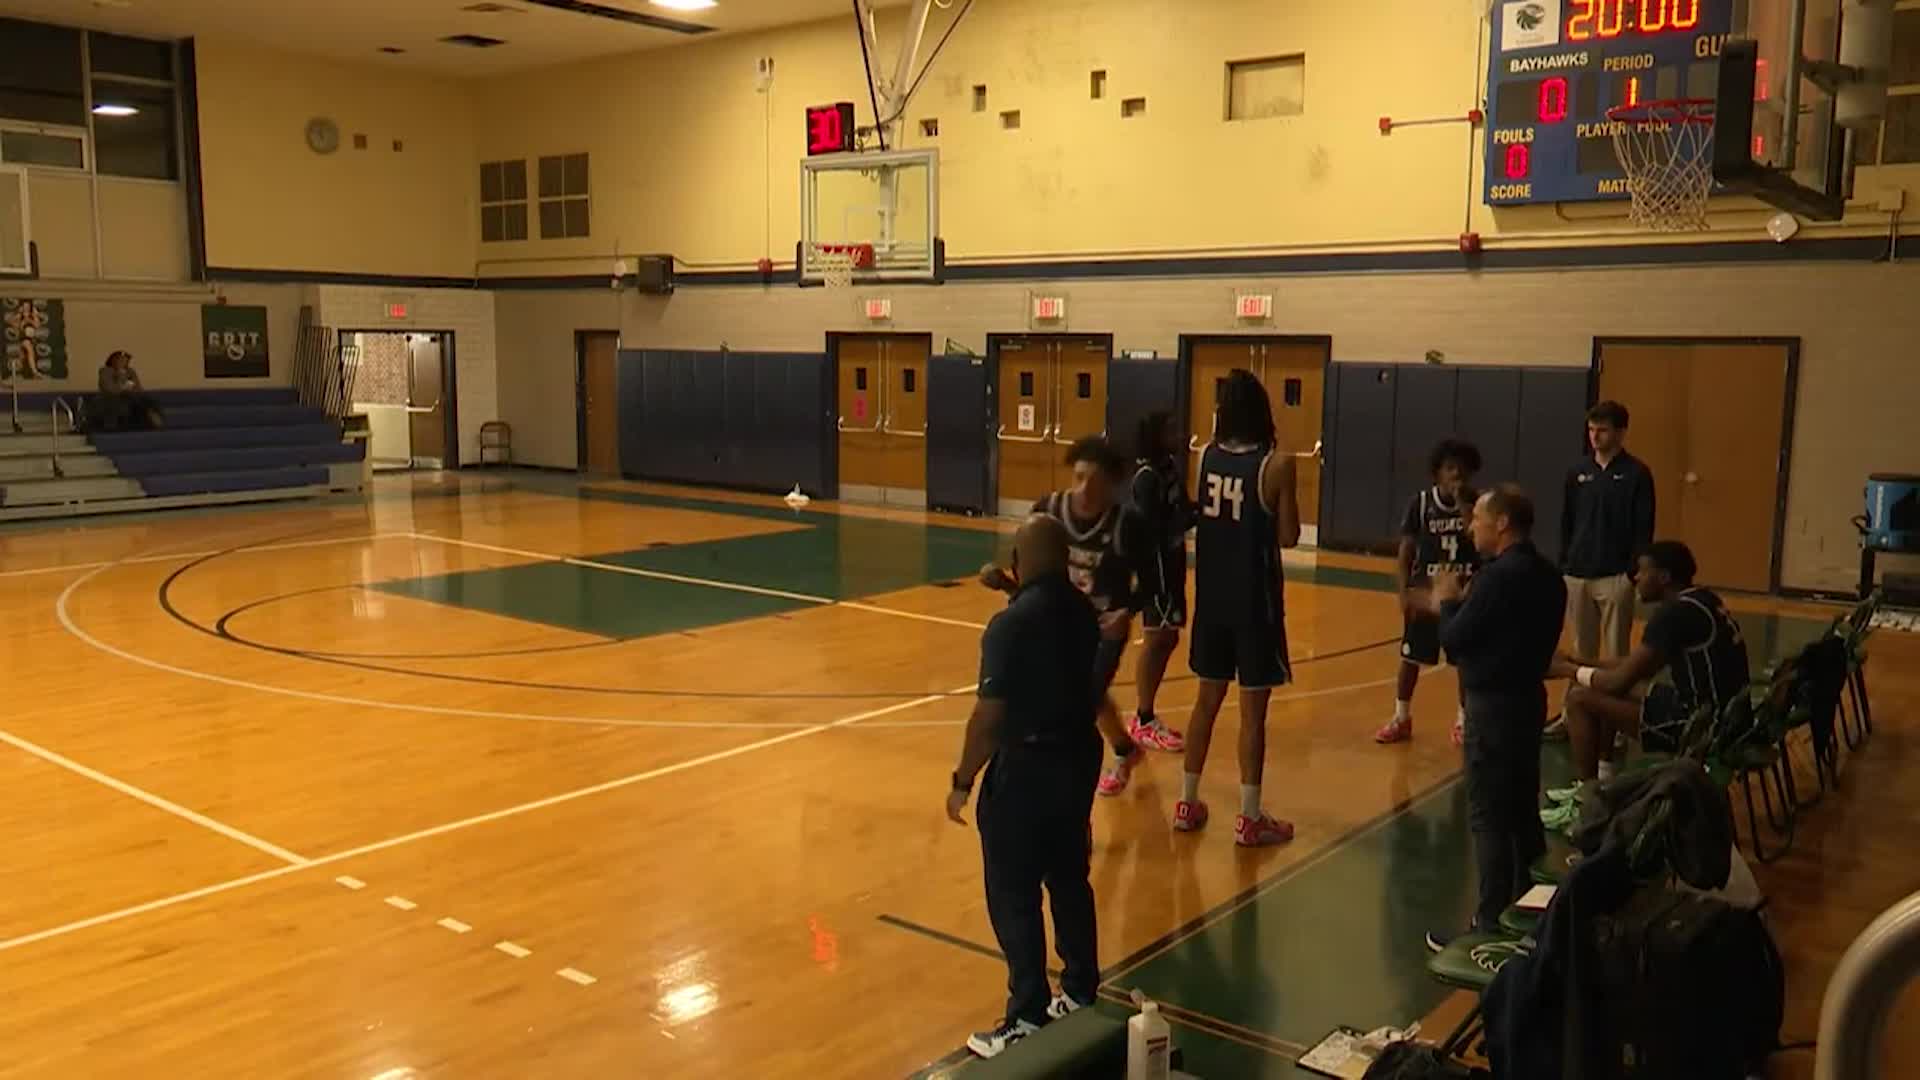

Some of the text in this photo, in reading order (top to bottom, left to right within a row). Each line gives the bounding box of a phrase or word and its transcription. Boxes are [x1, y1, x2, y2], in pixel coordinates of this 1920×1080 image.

[1566, 0, 1699, 41] 20:00
[1510, 52, 1588, 72] BAYHAWKS
[1603, 55, 1654, 71] PERIOD
[1538, 76, 1568, 123] 0
[810, 107, 842, 151] 30
[1493, 128, 1534, 144] FOULS
[1576, 121, 1626, 138] PLAYER
[1505, 143, 1529, 179] 0
[1490, 184, 1531, 199] SCORE
[1203, 472, 1245, 521] 34
[1441, 535, 1458, 561] 4
